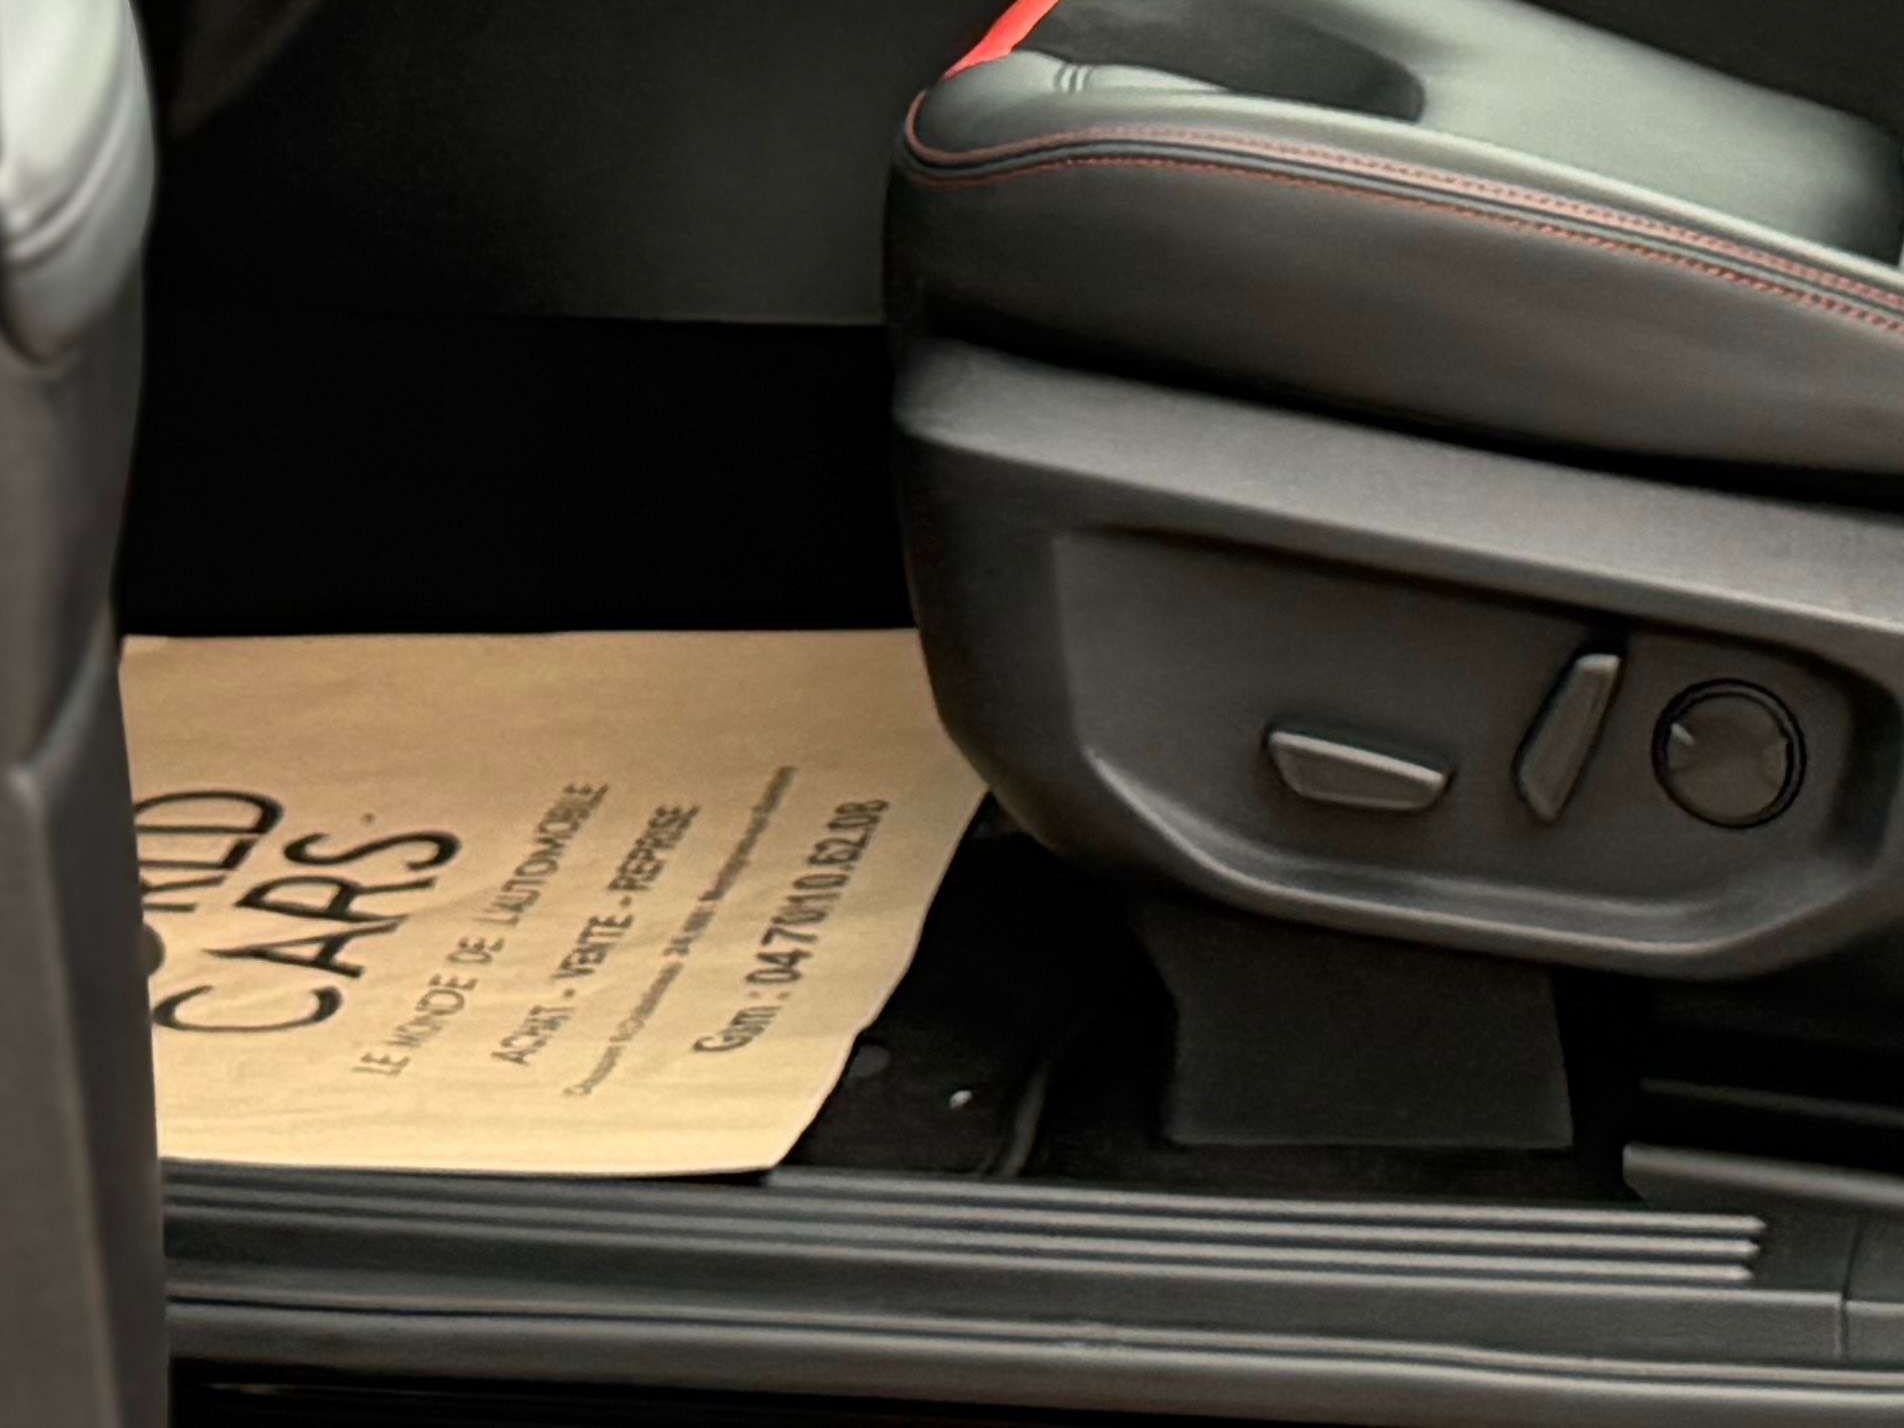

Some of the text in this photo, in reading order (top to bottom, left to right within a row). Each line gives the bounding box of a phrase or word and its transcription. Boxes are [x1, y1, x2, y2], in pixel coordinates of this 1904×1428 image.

[152, 830, 462, 1034] CARS
[351, 1052, 410, 1076] LE
[384, 973, 478, 1048] MONDE
[446, 937, 505, 965] DE
[490, 1004, 576, 1066] ACHAT
[549, 913, 634, 980] VENTE
[606, 805, 702, 892] REPRISE
